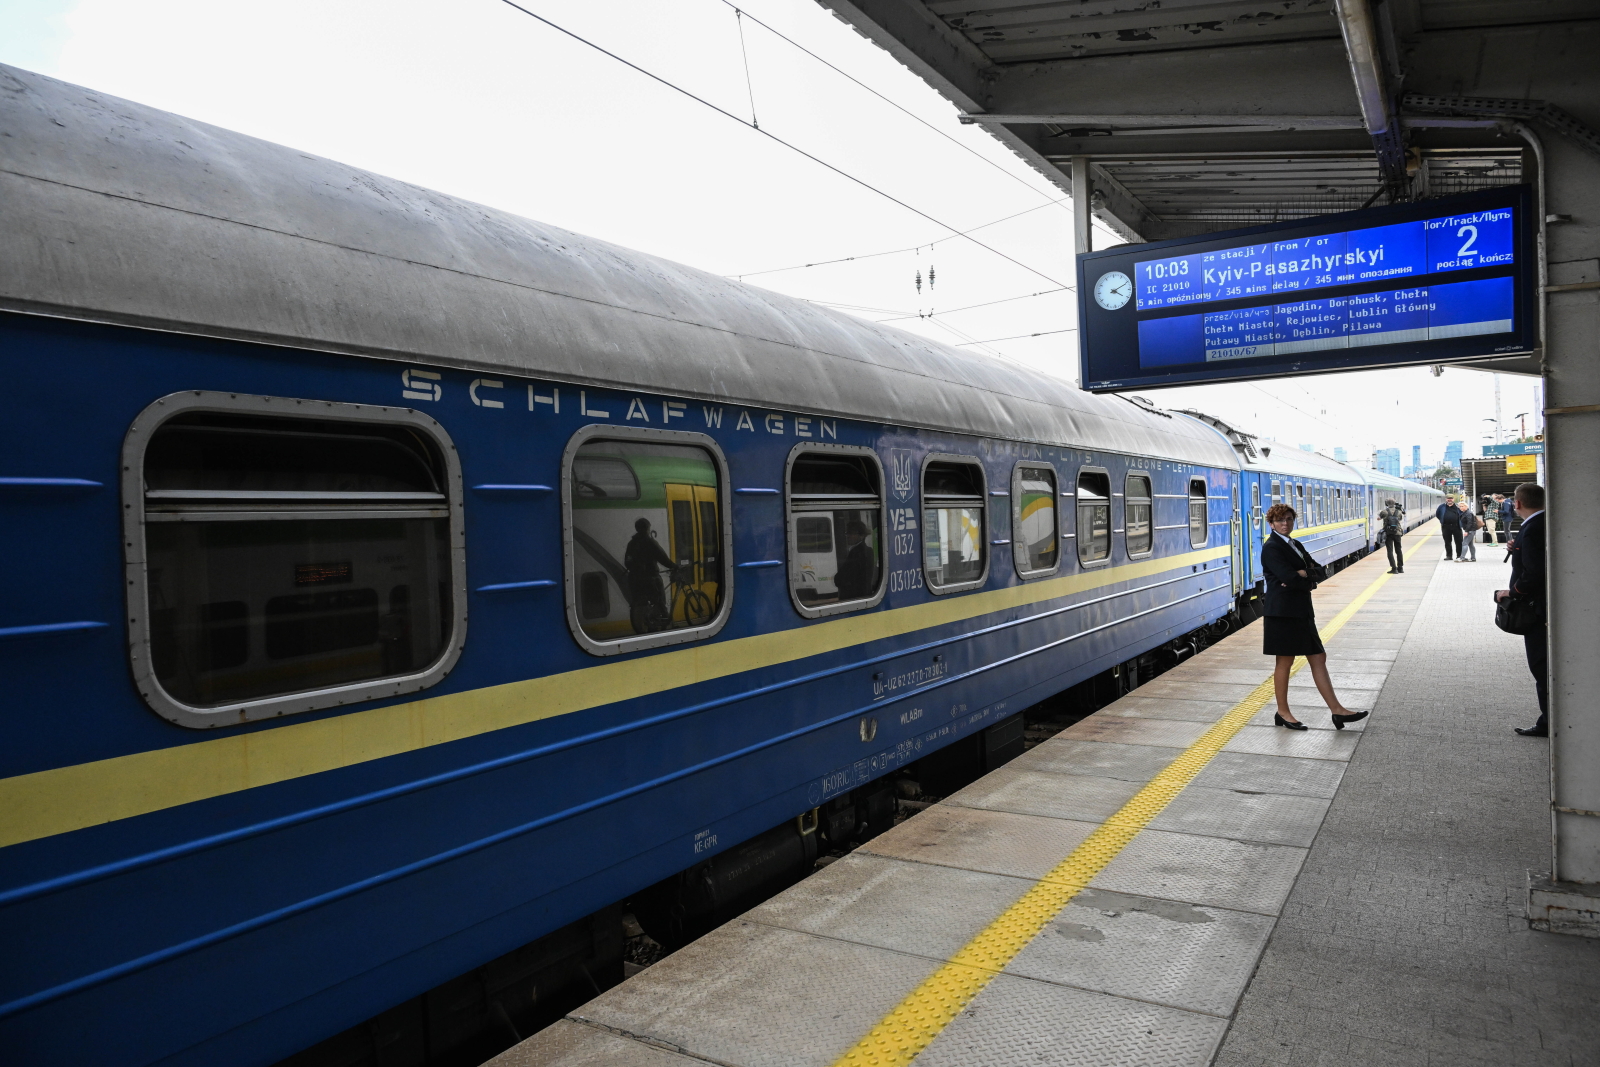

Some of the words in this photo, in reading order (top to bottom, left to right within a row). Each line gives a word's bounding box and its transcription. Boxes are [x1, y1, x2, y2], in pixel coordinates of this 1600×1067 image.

[1203, 254, 1215, 262] ze
[1221, 247, 1255, 260] stacji
[1274, 243, 1298, 251] from
[1457, 225, 1478, 257] 2
[1145, 260, 1189, 280] 10:03
[1203, 244, 1384, 286] Kyiv-Pasazhyrskyi
[1436, 258, 1474, 270] pociąg
[1147, 285, 1158, 294] IC
[1162, 281, 1190, 293] 21010
[1148, 296, 1163, 306] min
[1167, 291, 1212, 304] opóźniony
[1226, 286, 1242, 296] 345
[1246, 284, 1267, 294] mins
[1272, 279, 1300, 290] delay
[1315, 275, 1332, 285] 345
[1274, 302, 1323, 315] Jagodin,
[1329, 294, 1387, 309] Dorohusk,
[1394, 289, 1428, 301] Chełm
[1204, 325, 1233, 335] Chełm
[1239, 320, 1280, 331] Miasto,
[1286, 313, 1342, 326] Rejowiec,
[1349, 307, 1388, 319] Lublin
[1395, 302, 1436, 314] Główny
[1205, 336, 1239, 347] Puławy
[1245, 332, 1287, 343] Miasto,
[1342, 321, 1382, 332] Pilawa
[1211, 346, 1257, 359] 21010/67
[1124, 457, 1162, 471] VAGONE
[894, 533, 915, 556] 032
[890, 568, 923, 593] 03023
[900, 708, 924, 726] WLABm
